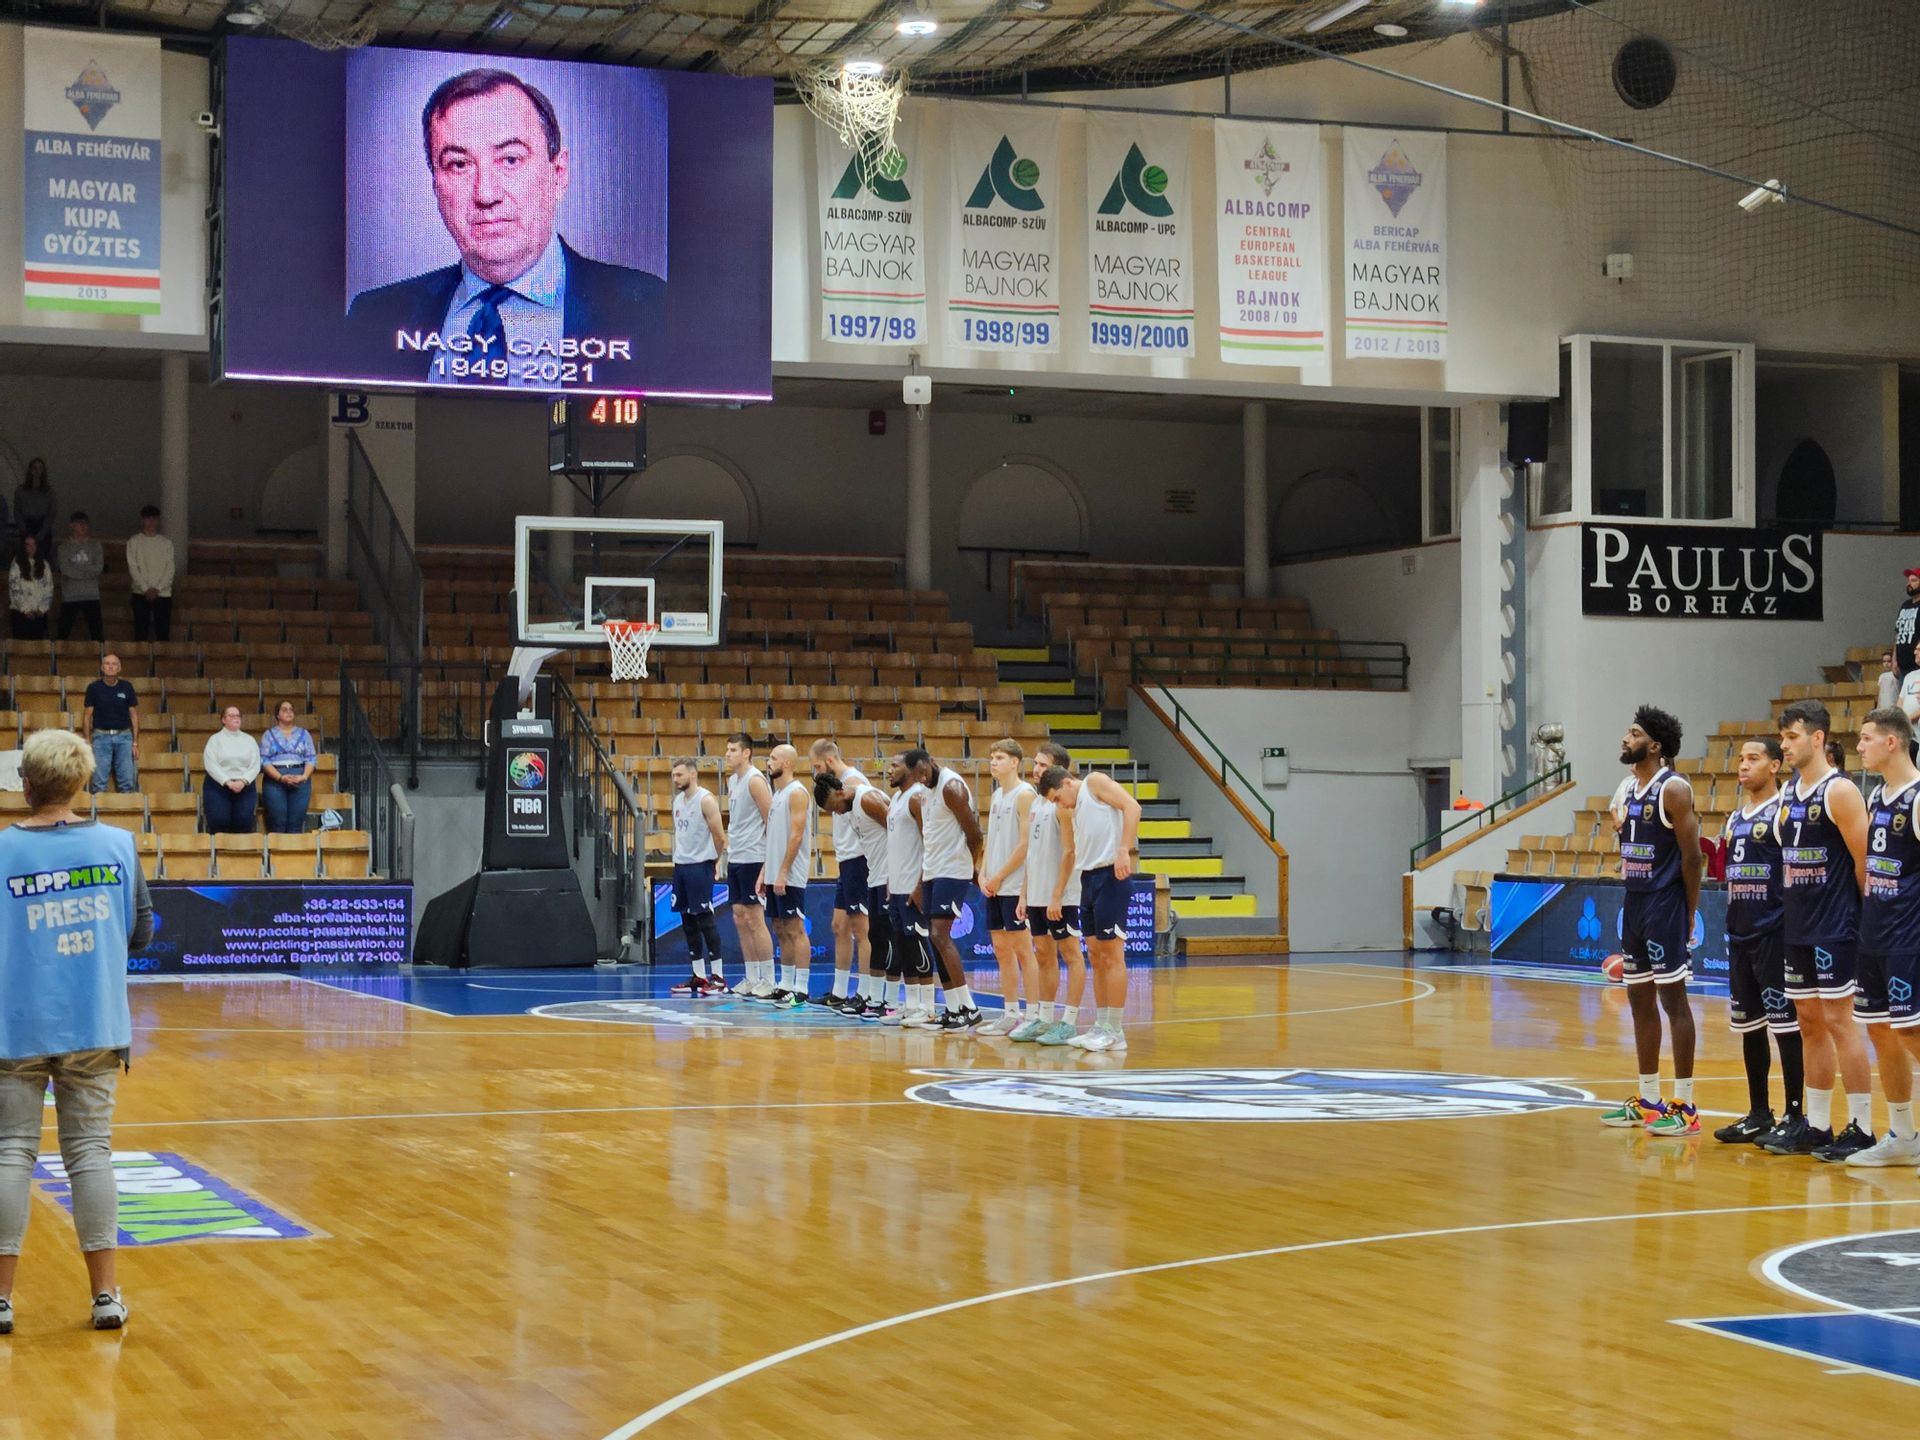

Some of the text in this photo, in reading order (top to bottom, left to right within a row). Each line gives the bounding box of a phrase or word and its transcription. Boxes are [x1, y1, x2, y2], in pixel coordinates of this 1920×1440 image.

[35, 139, 150, 160] ALBA FEHÉRVÁR
[49, 178, 136, 203] MAGYAR
[64, 207, 121, 230] KUPA
[827, 207, 912, 224] ALBACOMP-SZÜV
[1224, 199, 1311, 219] ALBACOMP
[963, 214, 1046, 230] ALBACOMP-SZÜV
[1096, 220, 1148, 234] ALBACOMP
[1158, 223, 1176, 236] UPC
[1245, 225, 1291, 238] CENTRAL
[1373, 226, 1419, 238] BERICAP
[44, 230, 140, 259] GYŐZTES
[824, 231, 915, 255] MAGYAR
[1240, 239, 1296, 253] EUROPEAN
[1354, 239, 1440, 254] ALBA FEHÉRVÁR
[826, 257, 913, 280] BAJNOK
[963, 248, 1050, 272] MAGYAR
[1094, 254, 1180, 277] MAGYAR
[1234, 254, 1302, 268] BASKETBALL
[965, 274, 1048, 297] BAJNOK
[1248, 269, 1288, 282] LEAGUE
[1352, 263, 1440, 286] MAGYAR
[78, 287, 108, 299] 2013
[1097, 279, 1178, 302] BAJNOK
[1236, 290, 1300, 307] BAJNOK
[1354, 291, 1440, 313] BAJNOK
[829, 314, 916, 342] 1997/98
[1240, 310, 1270, 323] 2008
[1283, 311, 1297, 324] 09
[397, 330, 497, 353] NAGY
[964, 318, 1050, 347] 1998/99
[1091, 322, 1189, 349] 1999/2000
[1354, 337, 1389, 351] 2012
[1408, 338, 1440, 353] 2013
[435, 357, 593, 382] 1949-2021
[332, 394, 369, 424] B
[1589, 527, 1815, 593] PAULUS
[1628, 592, 1777, 614] BORHÁZ
[513, 798, 542, 814] FIBA
[1629, 819, 1636, 843] 1
[1793, 821, 1802, 847] 7
[1872, 827, 1887, 853] 8
[1733, 838, 1746, 863] 5
[26, 894, 110, 930] PRESS
[273, 912, 404, 923] alba-kor@alba-kor.hu
[57, 929, 95, 955] 433
[225, 939, 404, 951] www.pickling-passivation.eu
[290, 952, 338, 964] Berényi
[341, 951, 354, 962] út
